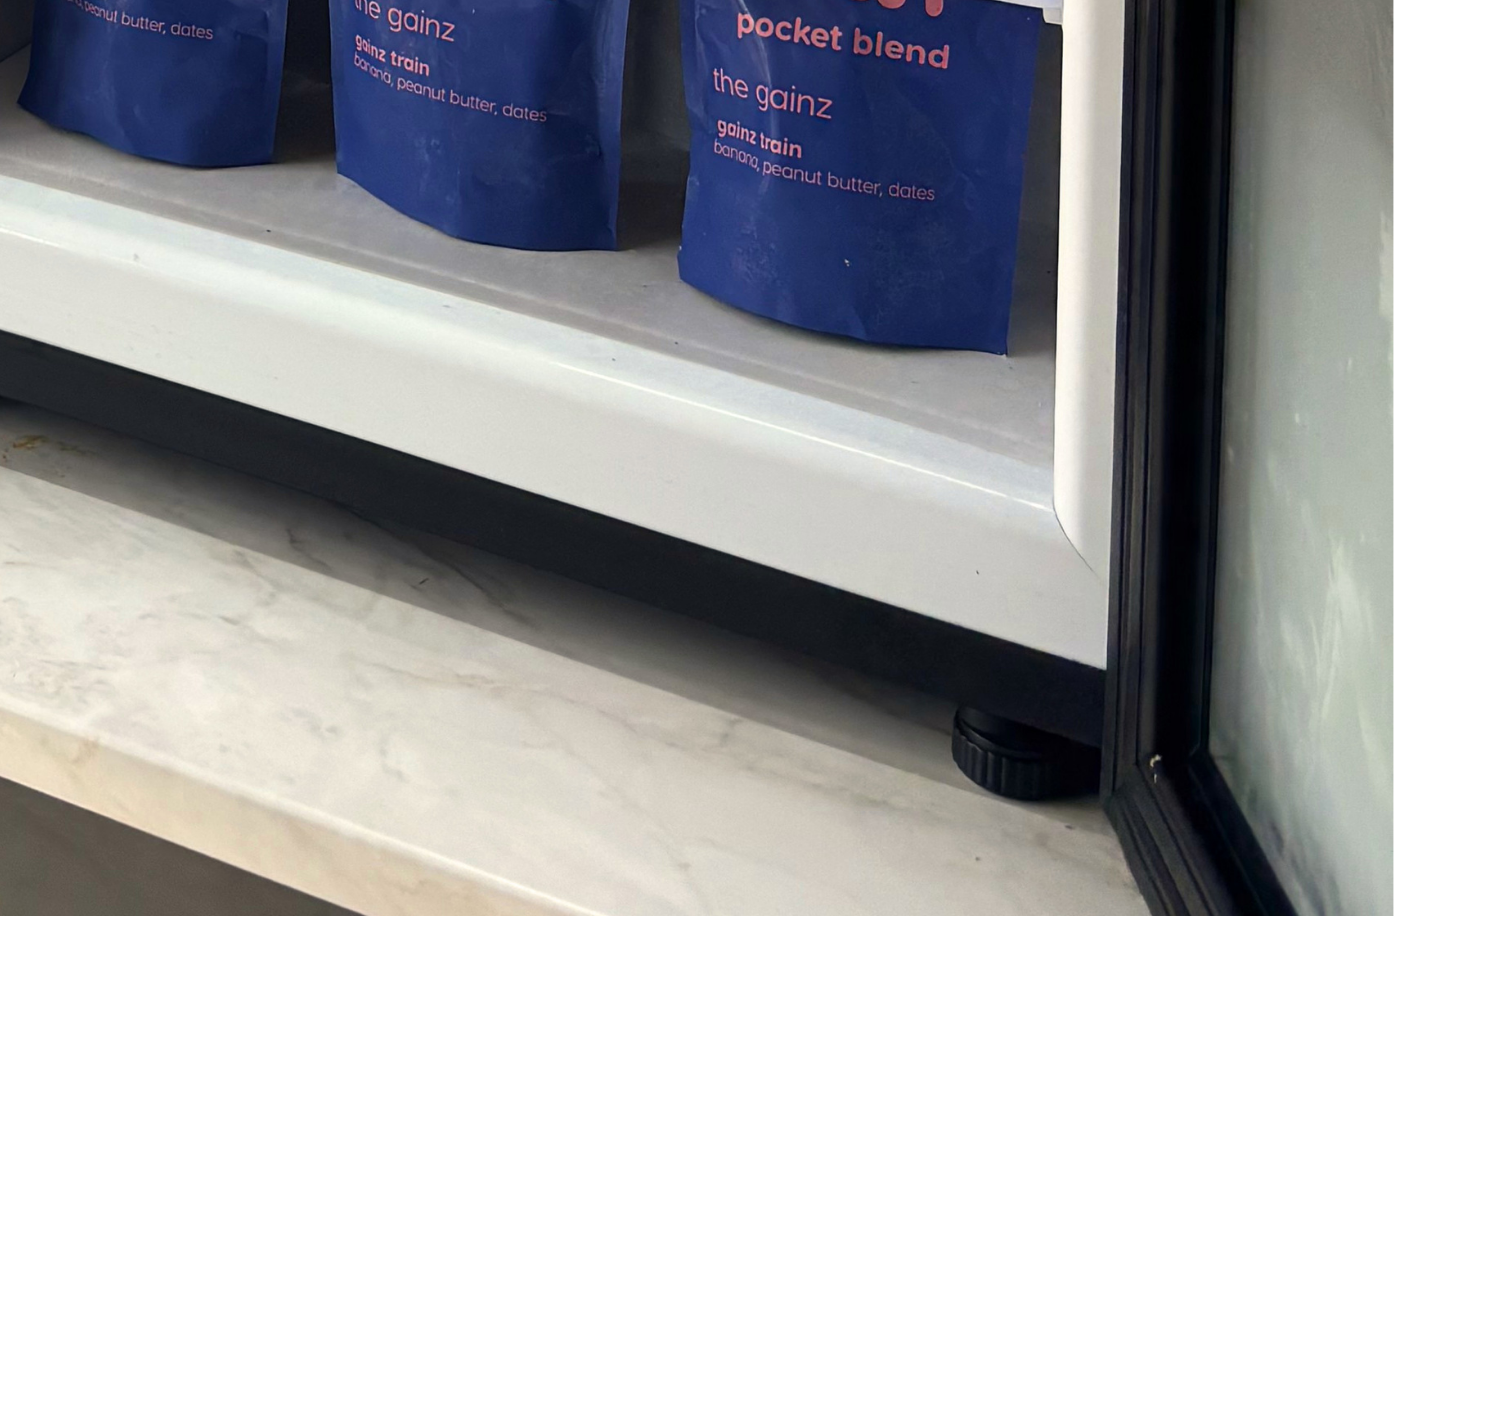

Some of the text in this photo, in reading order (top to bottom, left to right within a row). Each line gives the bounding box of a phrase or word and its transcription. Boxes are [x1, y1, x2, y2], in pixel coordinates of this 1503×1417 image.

[84, 0, 118, 23] peanut
[121, 11, 167, 35] butter,
[170, 22, 214, 40] dates
[387, 7, 455, 42] gainz
[737, 12, 950, 69] pocket blend
[355, 34, 430, 77] gainz train
[397, 77, 446, 102] peanut
[449, 89, 498, 116] butter,
[502, 103, 547, 122] dates
[712, 67, 833, 119] the gainz
[717, 119, 802, 159] gainz train
[762, 160, 822, 186] peanut
[827, 172, 884, 198] butter,
[888, 182, 935, 201] dates
